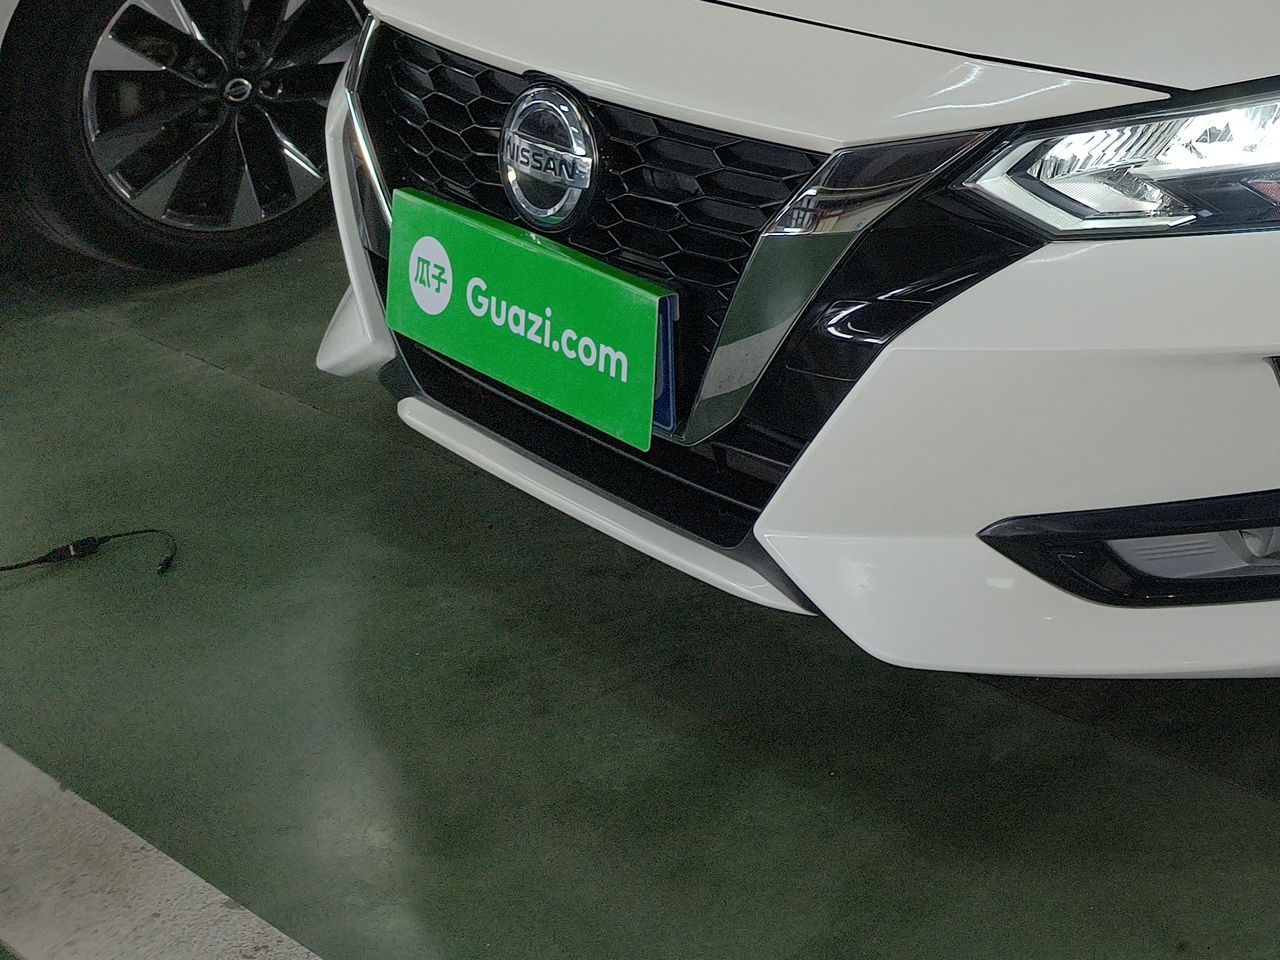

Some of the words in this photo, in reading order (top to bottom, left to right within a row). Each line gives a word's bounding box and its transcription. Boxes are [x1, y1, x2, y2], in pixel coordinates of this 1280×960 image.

[506, 136, 576, 179] NISSAN
[414, 256, 447, 293] 瓜子
[466, 278, 628, 382] Guazi.com
